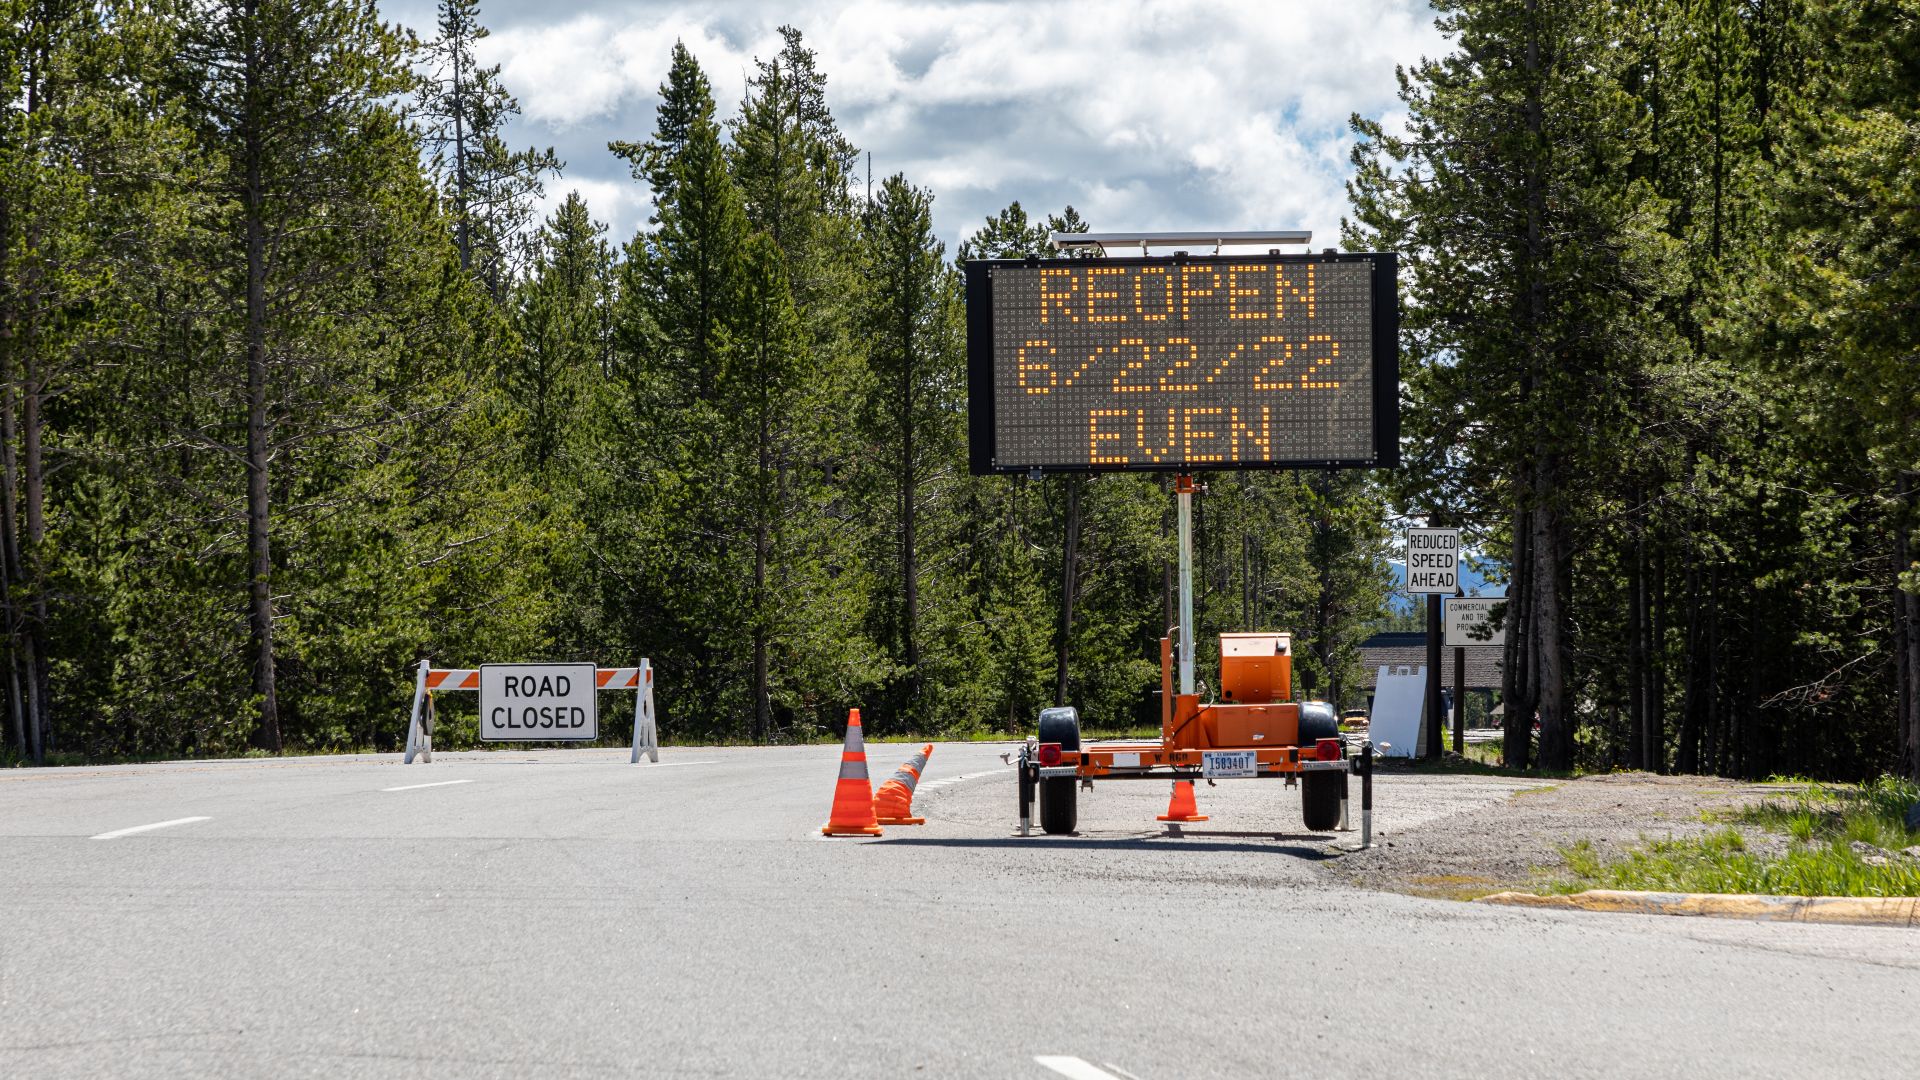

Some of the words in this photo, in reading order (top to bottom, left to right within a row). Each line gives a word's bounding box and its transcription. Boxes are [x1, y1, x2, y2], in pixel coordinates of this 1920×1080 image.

[1040, 264, 1315, 323] REOPEN
[1018, 335, 1340, 394] 6/22/22
[1090, 407, 1270, 463] EVEN
[1410, 534, 1456, 549] REDUCED
[1412, 553, 1453, 568] SPEED
[1410, 572, 1455, 588] AHEAD
[1449, 603, 1489, 611] COMMERCIAL
[1461, 613, 1474, 621] AND
[504, 675, 571, 698] ROAD
[491, 706, 586, 729] CLOSED
